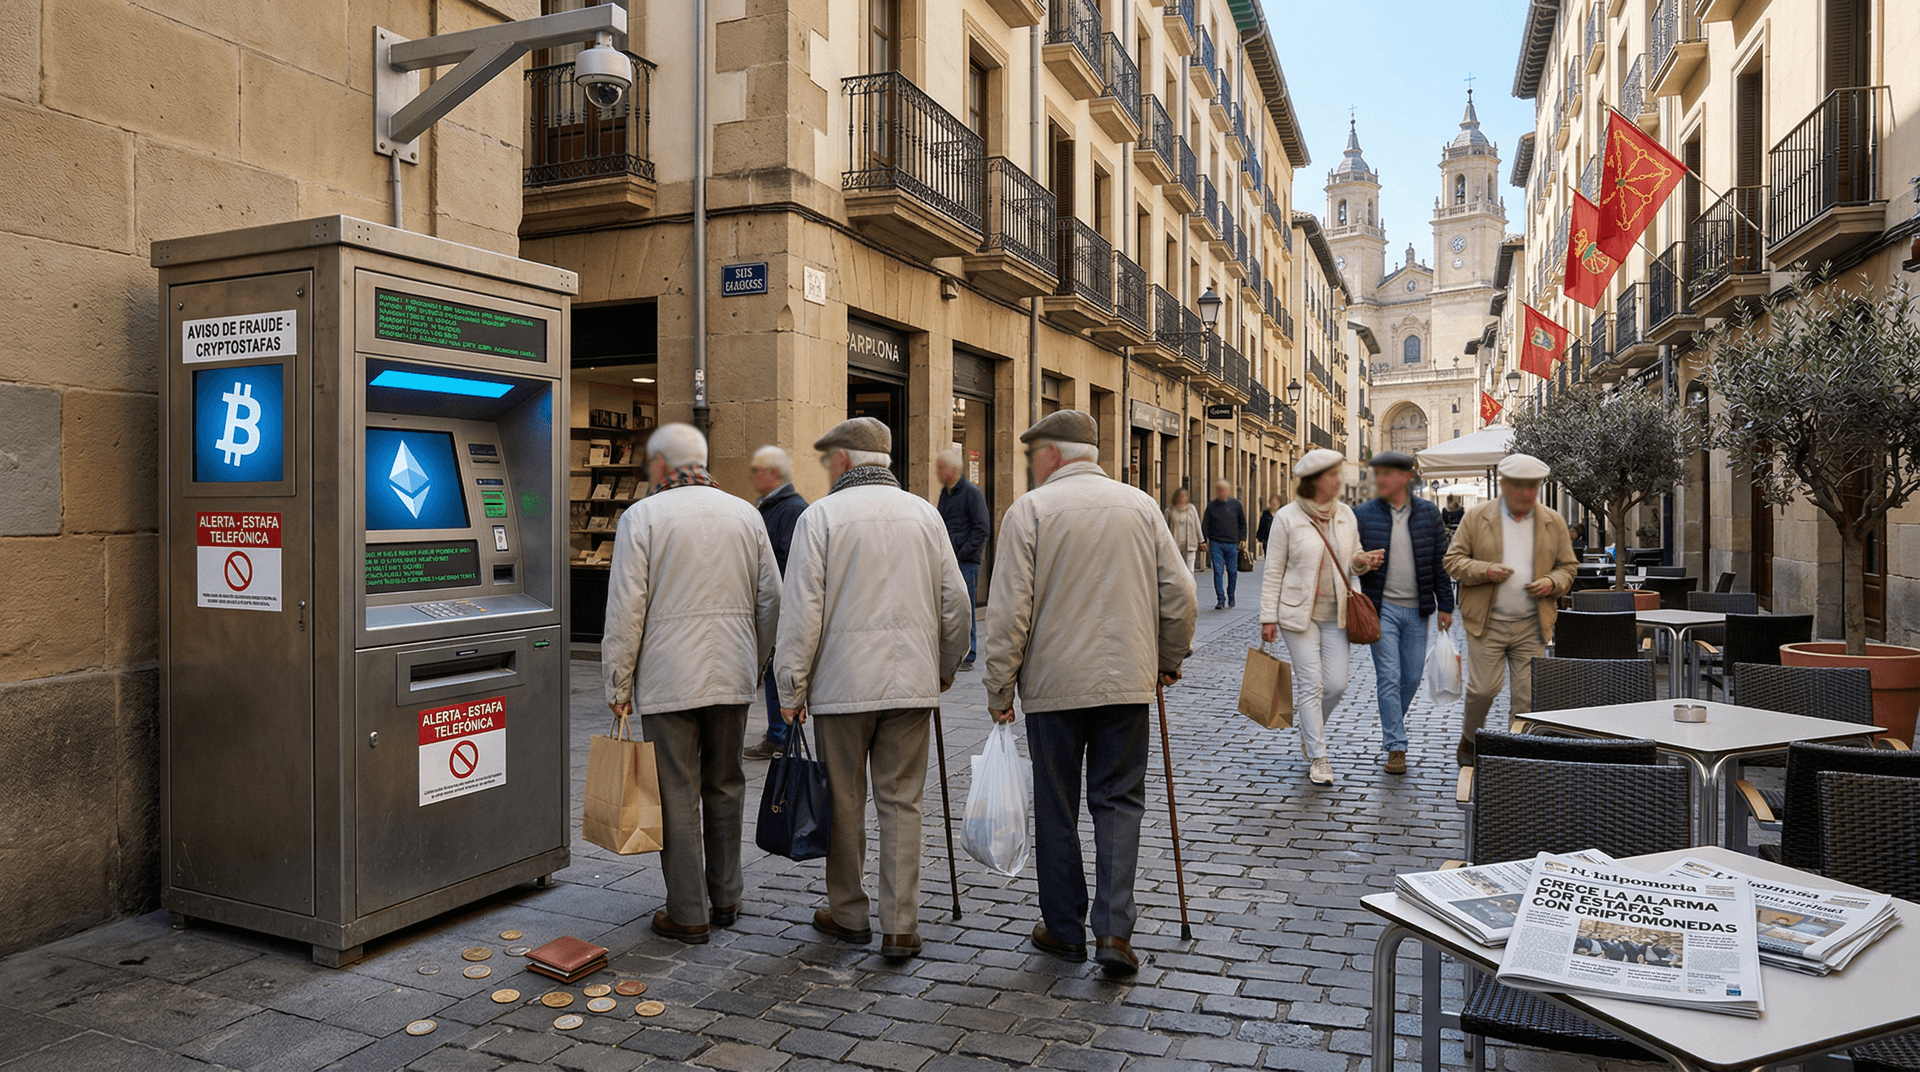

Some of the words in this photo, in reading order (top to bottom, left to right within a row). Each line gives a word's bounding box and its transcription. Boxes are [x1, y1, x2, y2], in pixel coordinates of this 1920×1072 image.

[187, 323, 220, 339] AVISO
[222, 321, 237, 336] DE
[239, 317, 283, 334] FRAUDE
[195, 336, 281, 357] CRYPTOSTAFAS
[199, 515, 235, 528] ALERTA
[242, 515, 279, 529] ESTAFA
[209, 528, 269, 544] TELEFÓNICA
[422, 708, 461, 727] ALERTA
[468, 700, 503, 718] ESTAFA
[434, 716, 494, 738] TELEFÓNICA
[1535, 886, 1575, 902] POR
[1579, 894, 1665, 916] ESTAFAS
[1539, 877, 1600, 897] CRECE
[1604, 889, 1629, 902] LA
[1632, 893, 1719, 912] ALARMA
[1532, 897, 1571, 912] CON
[1574, 905, 1739, 933] CRIPTOMONEDAS
